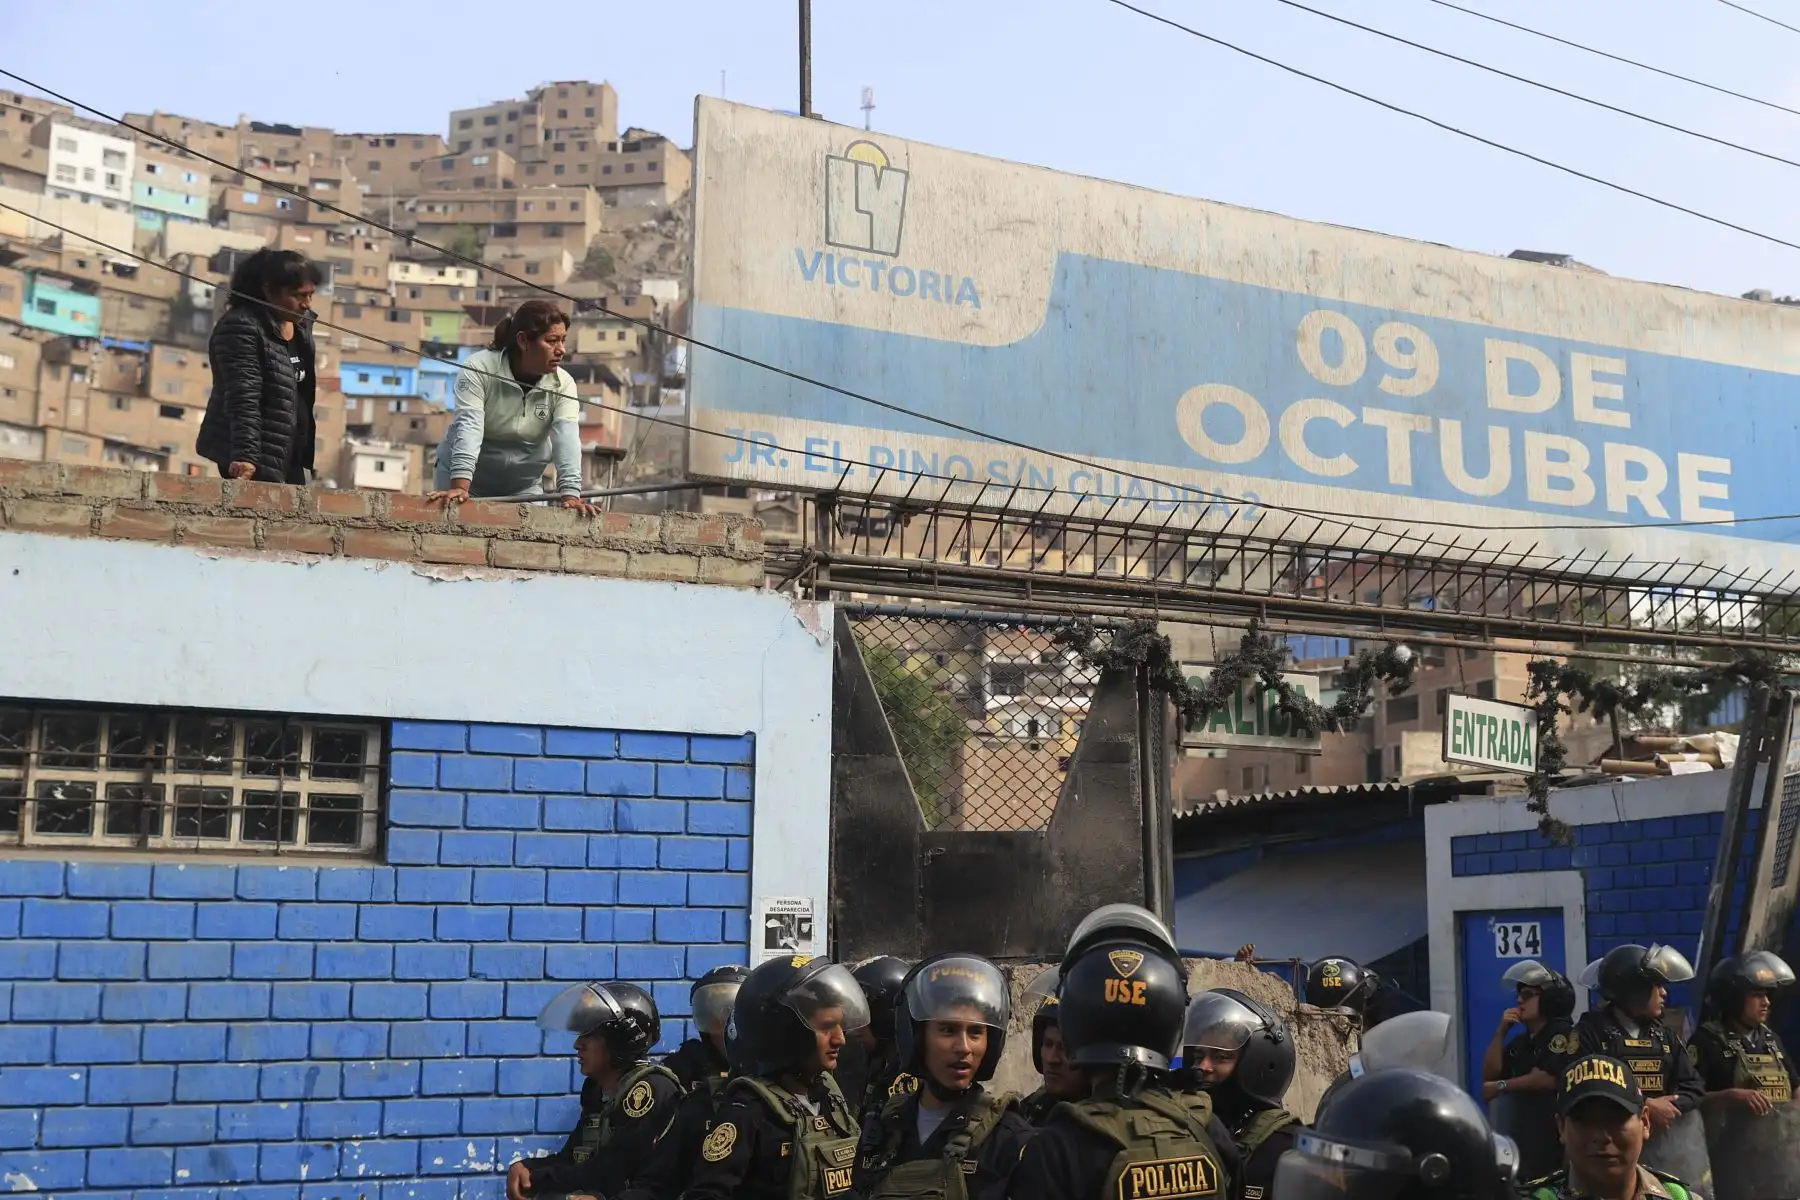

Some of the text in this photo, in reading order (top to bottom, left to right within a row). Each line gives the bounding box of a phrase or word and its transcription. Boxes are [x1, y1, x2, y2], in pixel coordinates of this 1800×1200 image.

[794, 247, 982, 309] VICTORIA
[1297, 309, 1632, 429] 09 DE
[723, 427, 1261, 522] JR. EL PINO S/N CUADRA 2
[1175, 383, 1736, 527] OCTUBRE
[1452, 708, 1533, 767] ENTRADA
[1497, 925, 1540, 956] 374
[1104, 978, 1147, 1005] USE
[1321, 976, 1342, 988] USE
[1565, 1058, 1627, 1093] POLICIA
[1131, 1161, 1209, 1198] POLICIA
